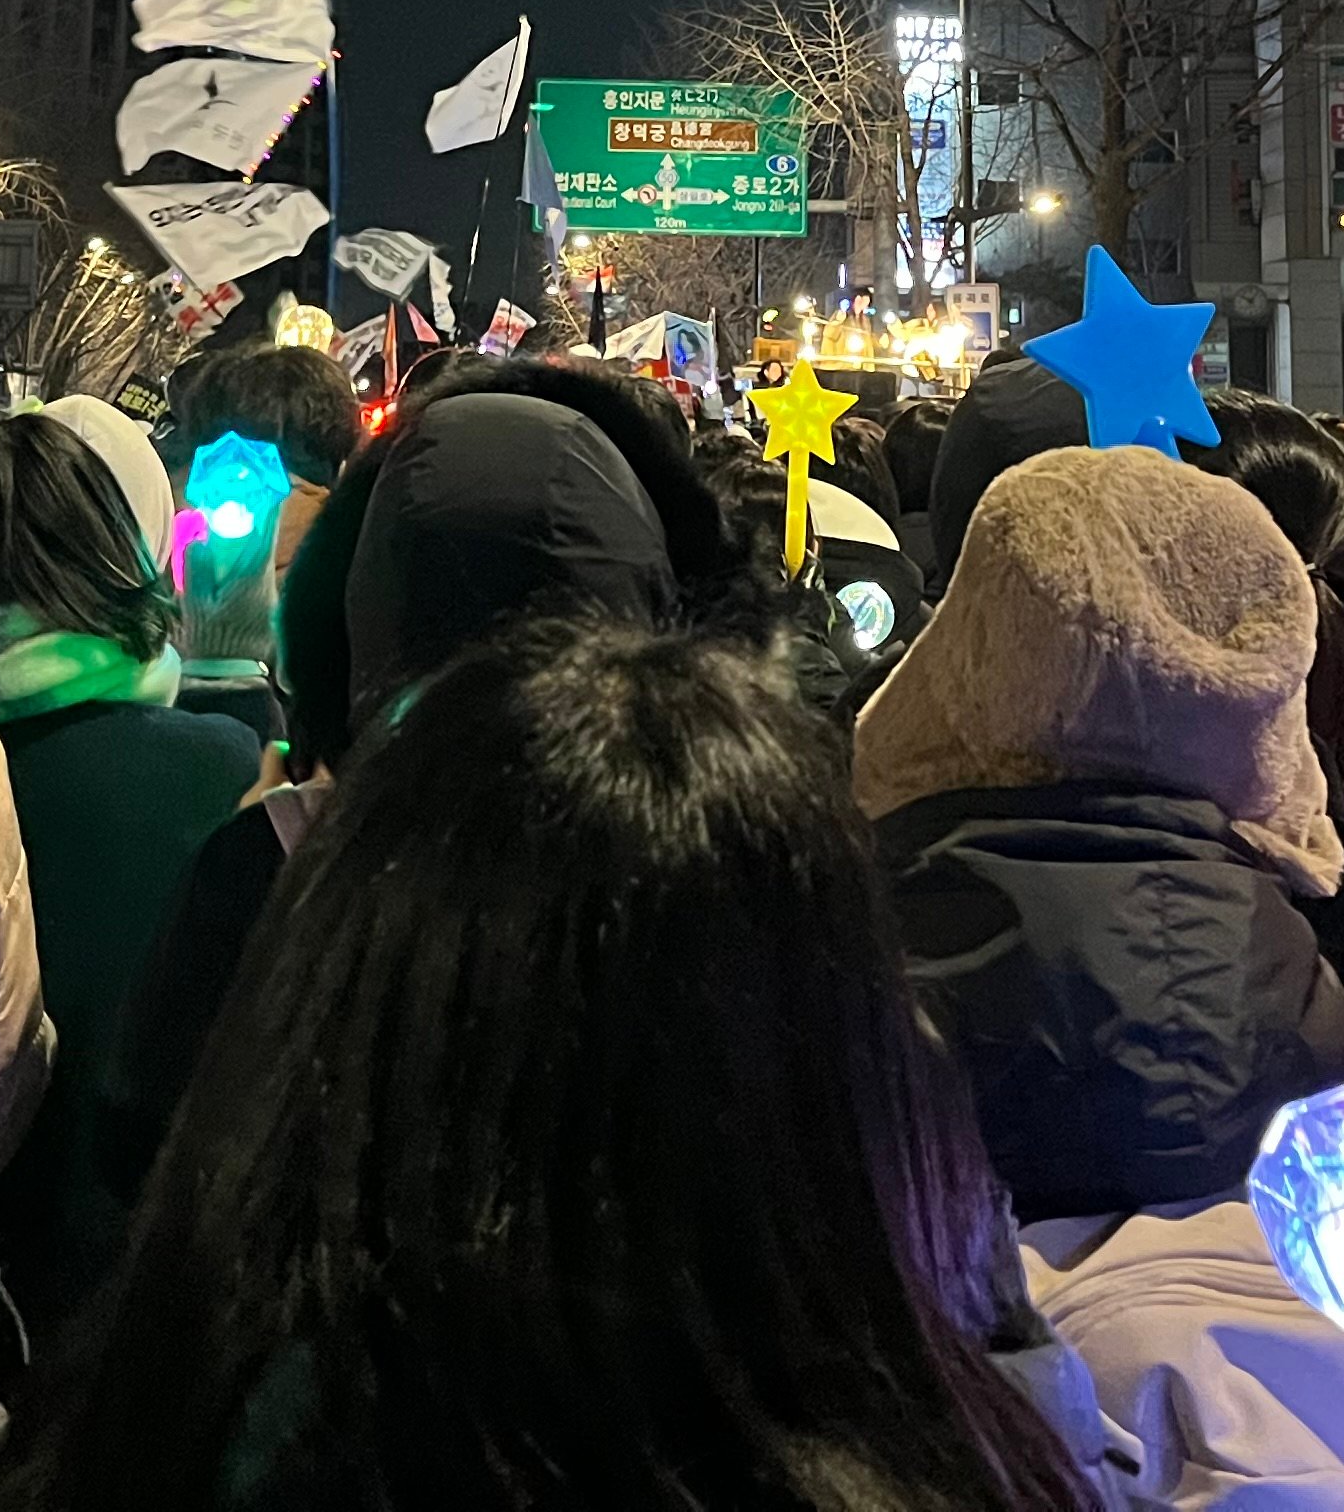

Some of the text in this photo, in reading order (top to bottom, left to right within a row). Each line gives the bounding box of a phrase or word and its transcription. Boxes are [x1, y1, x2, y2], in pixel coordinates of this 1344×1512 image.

[614, 122, 666, 142] 창덕궁
[777, 156, 789, 172] 6
[555, 172, 618, 192] 법재판소
[732, 175, 800, 196] 종로2가
[654, 216, 687, 228] 120m
